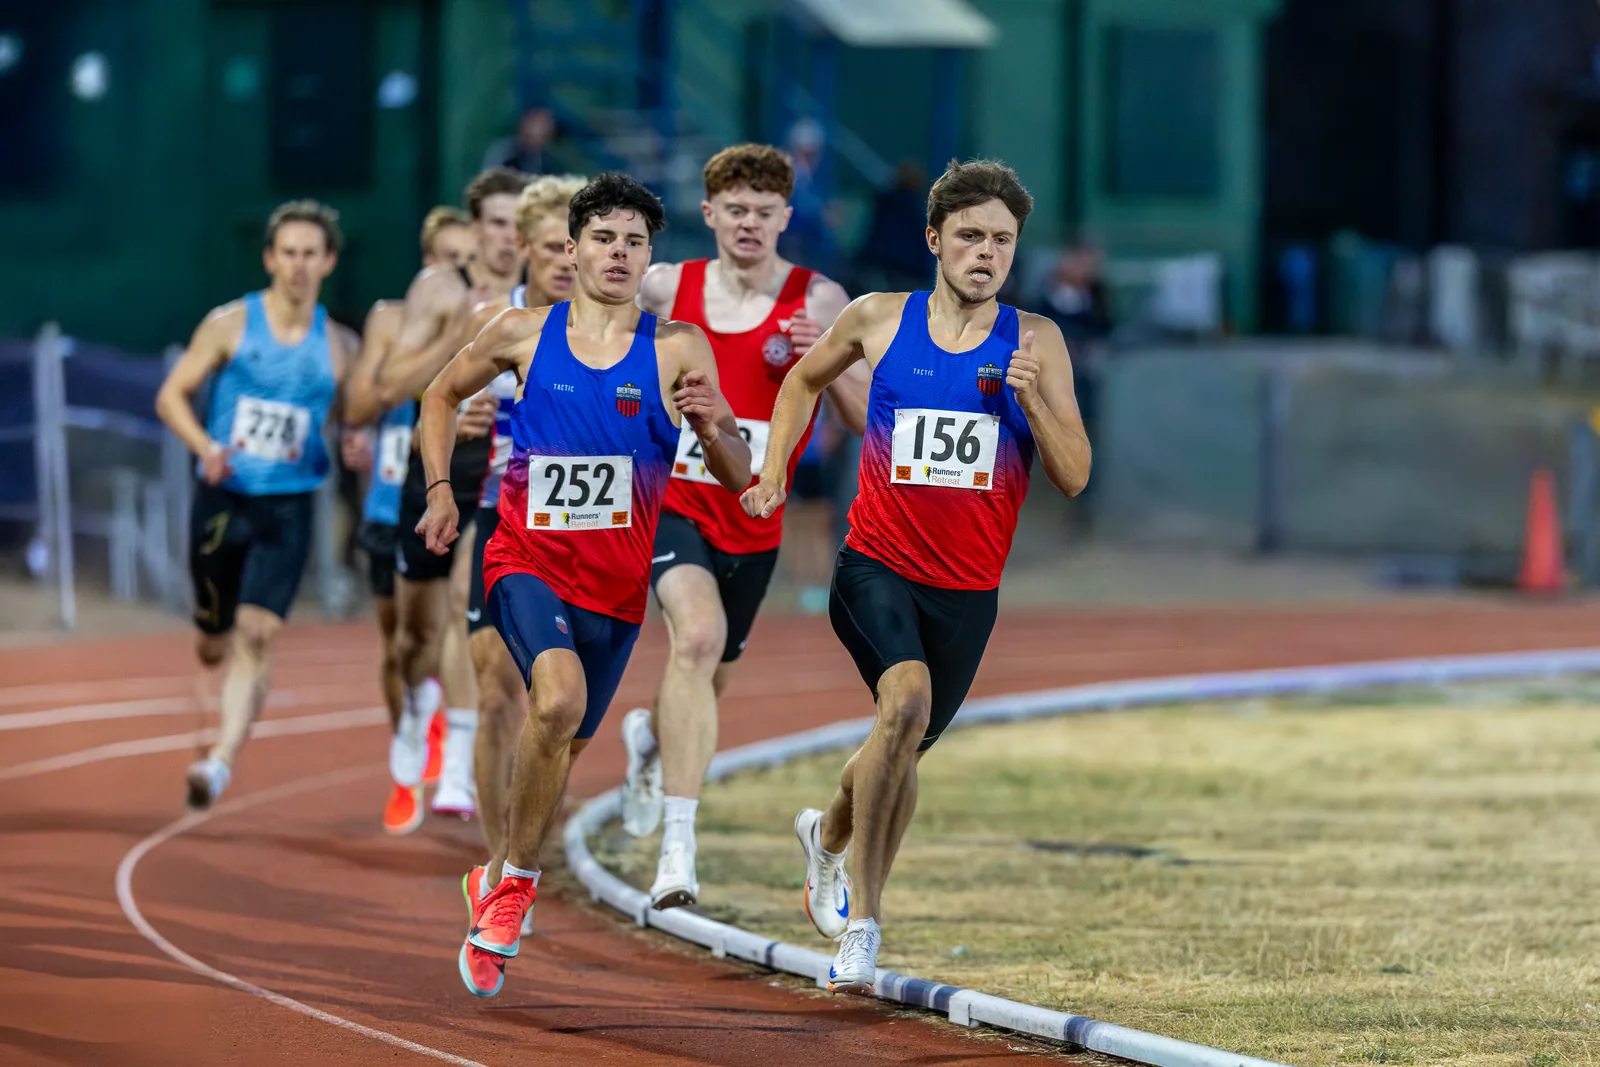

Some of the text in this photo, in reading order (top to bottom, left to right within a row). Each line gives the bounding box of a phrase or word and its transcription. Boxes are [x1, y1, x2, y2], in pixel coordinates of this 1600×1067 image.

[913, 367, 934, 377] TACTIC
[553, 383, 575, 393] TACTIC
[913, 416, 980, 464] 156
[544, 462, 615, 508] 252
[931, 475, 960, 486] Retreat
[571, 520, 598, 528] Retreat
